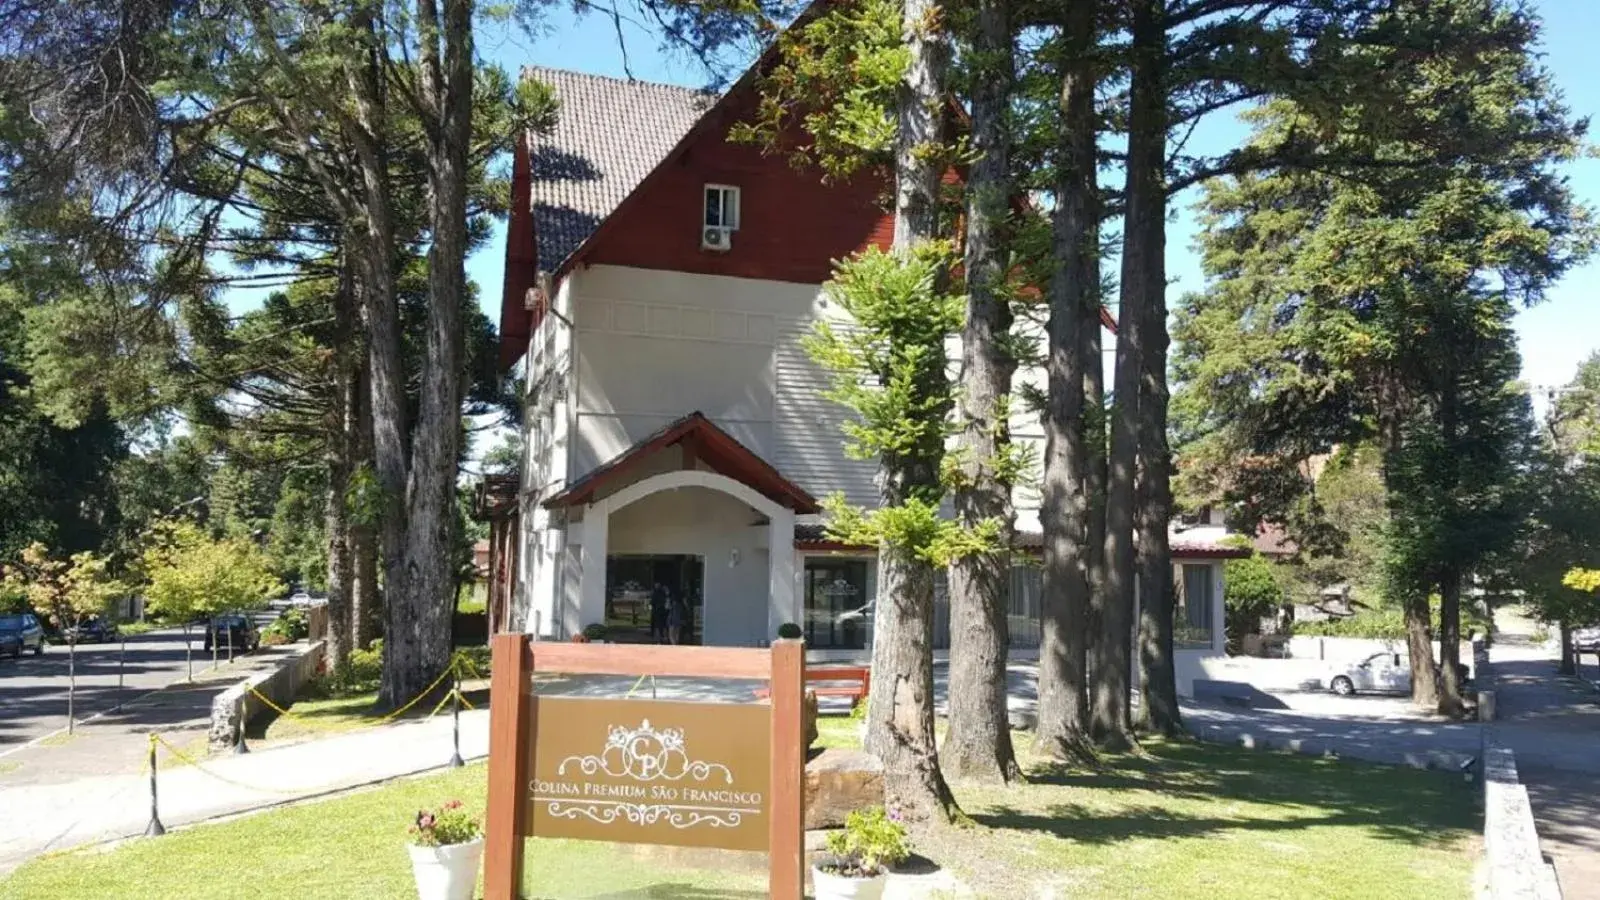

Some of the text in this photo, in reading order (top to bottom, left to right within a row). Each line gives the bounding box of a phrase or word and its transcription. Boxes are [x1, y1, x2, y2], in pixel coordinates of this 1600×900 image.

[528, 779, 762, 804] COLINA PREMIUM SÃO FRANCISCO
